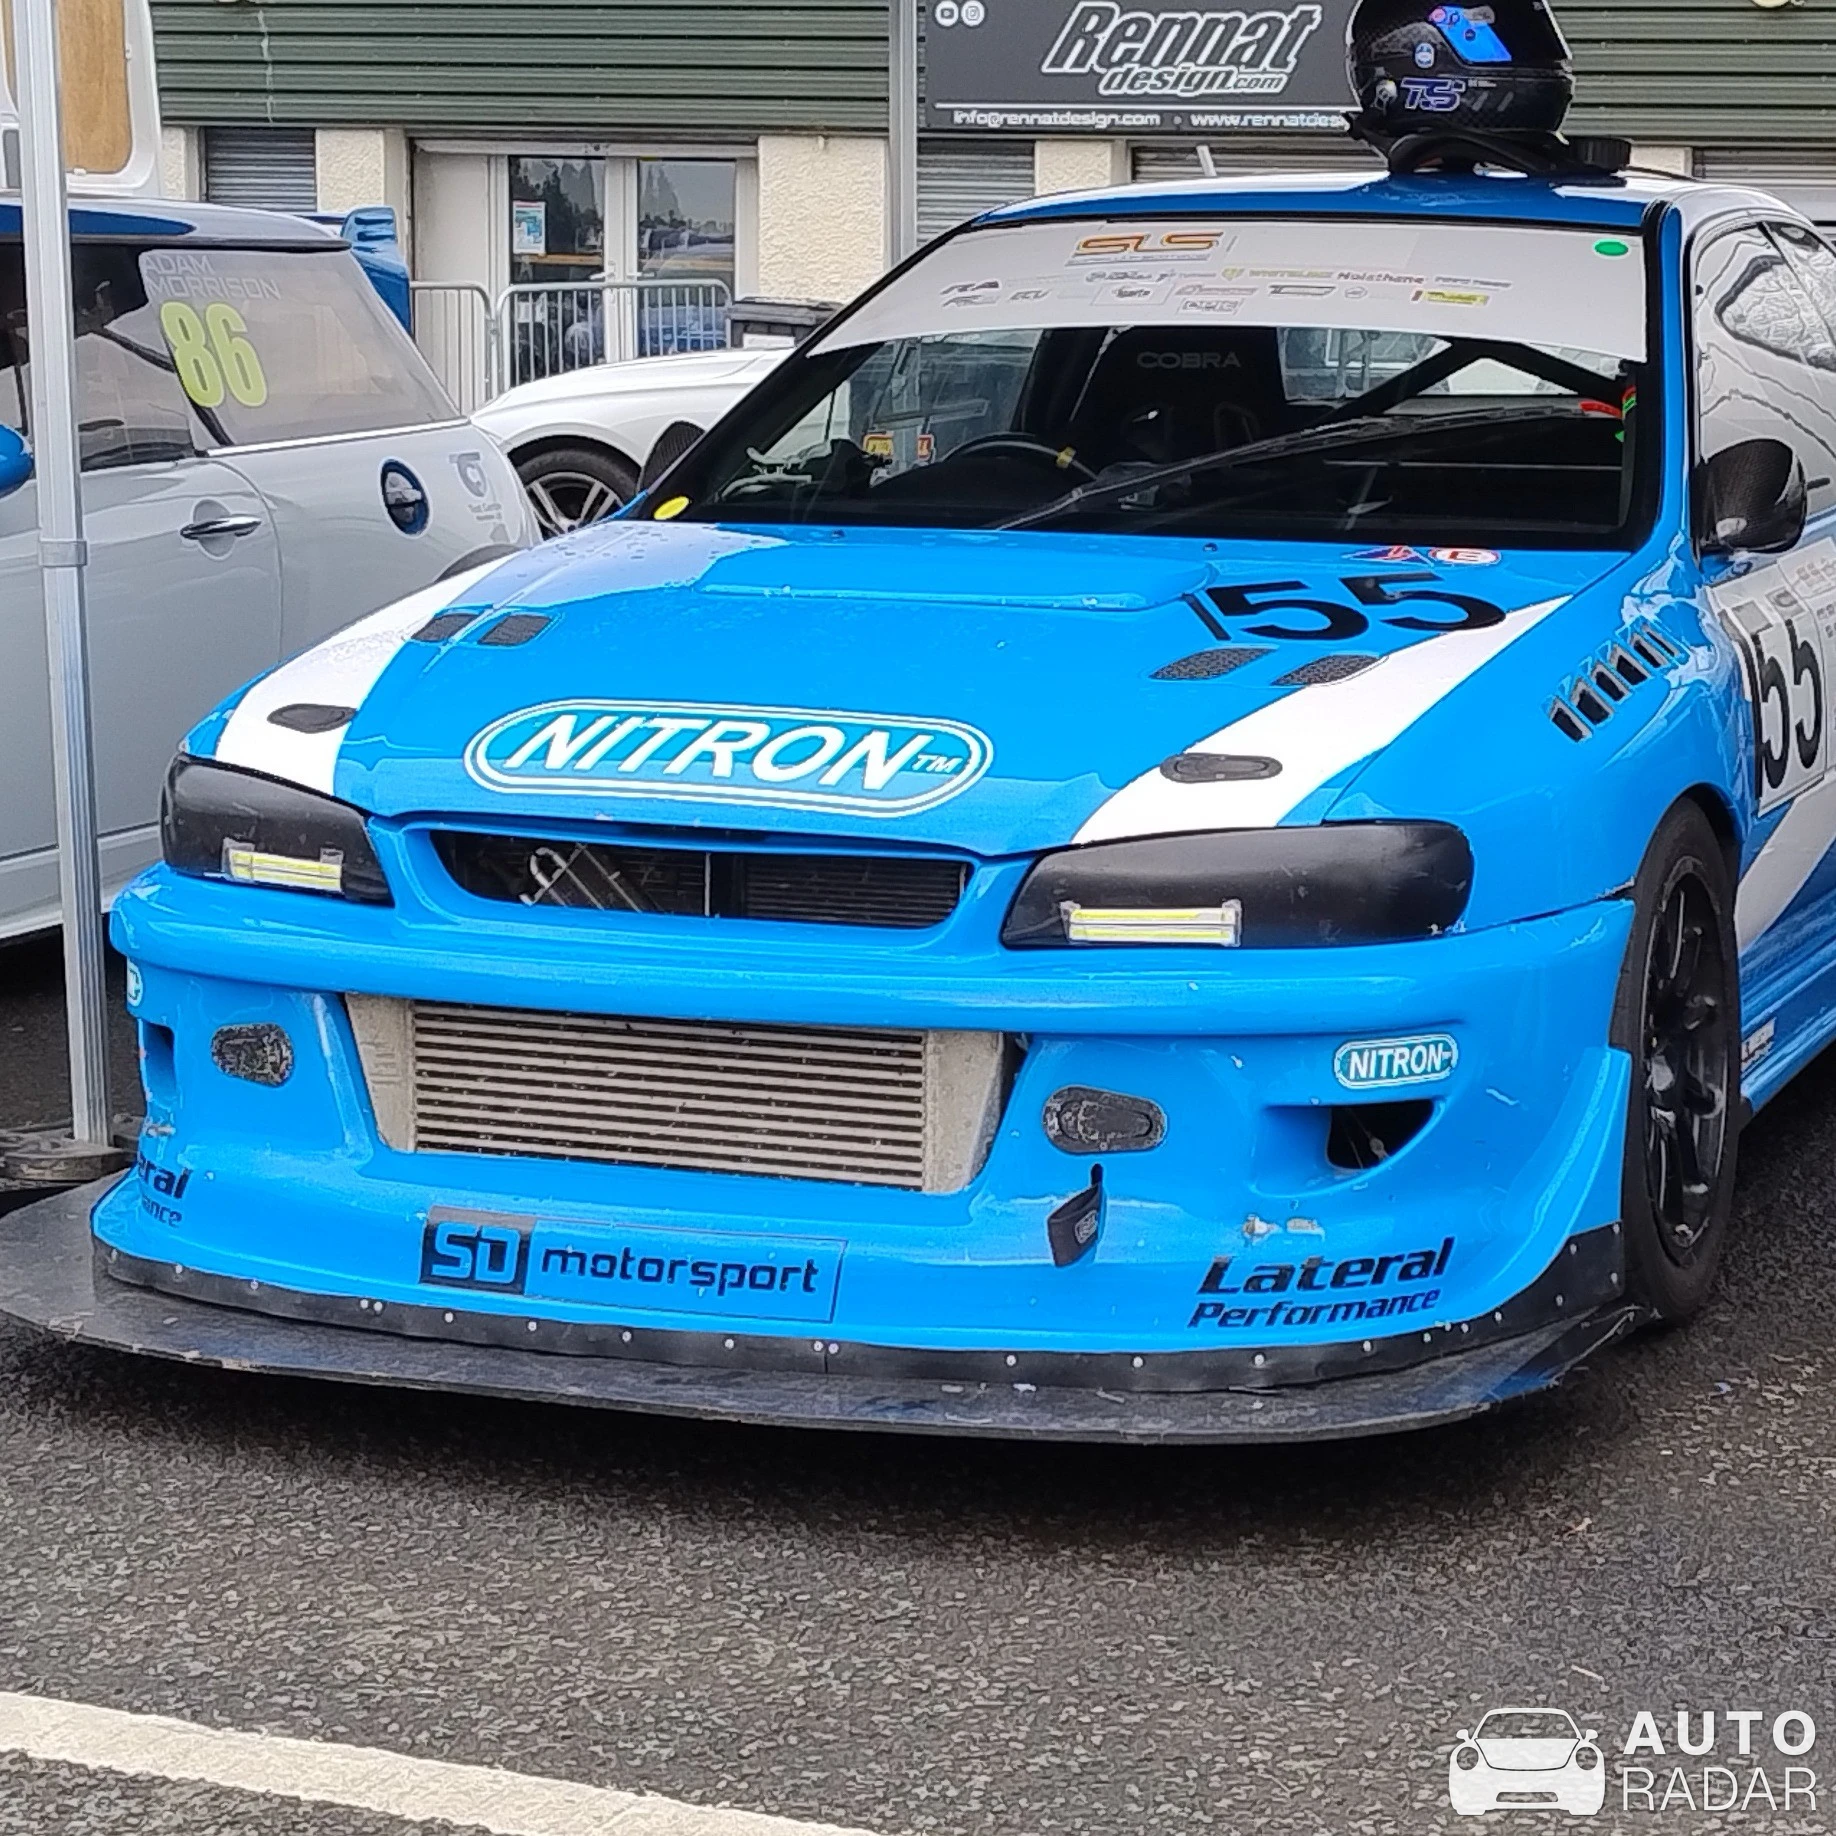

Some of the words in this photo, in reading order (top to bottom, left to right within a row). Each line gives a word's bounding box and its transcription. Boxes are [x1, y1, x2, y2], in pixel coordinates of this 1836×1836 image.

[1042, 2, 1321, 73] Rennat
[1099, 64, 1290, 96] design.com
[953, 108, 1161, 128] info@rennatdesign.com
[144, 254, 216, 275] ADAM
[145, 275, 281, 300] MORRISON
[160, 300, 267, 408] 86
[1136, 351, 1242, 369] COBRA
[502, 713, 935, 791] NITRON
[1348, 1042, 1444, 1080] NITRON
[431, 1220, 522, 1286] SD
[541, 1246, 819, 1297] motorsport
[1196, 1236, 1456, 1296] Lateral
[1187, 1288, 1442, 1329] Performance
